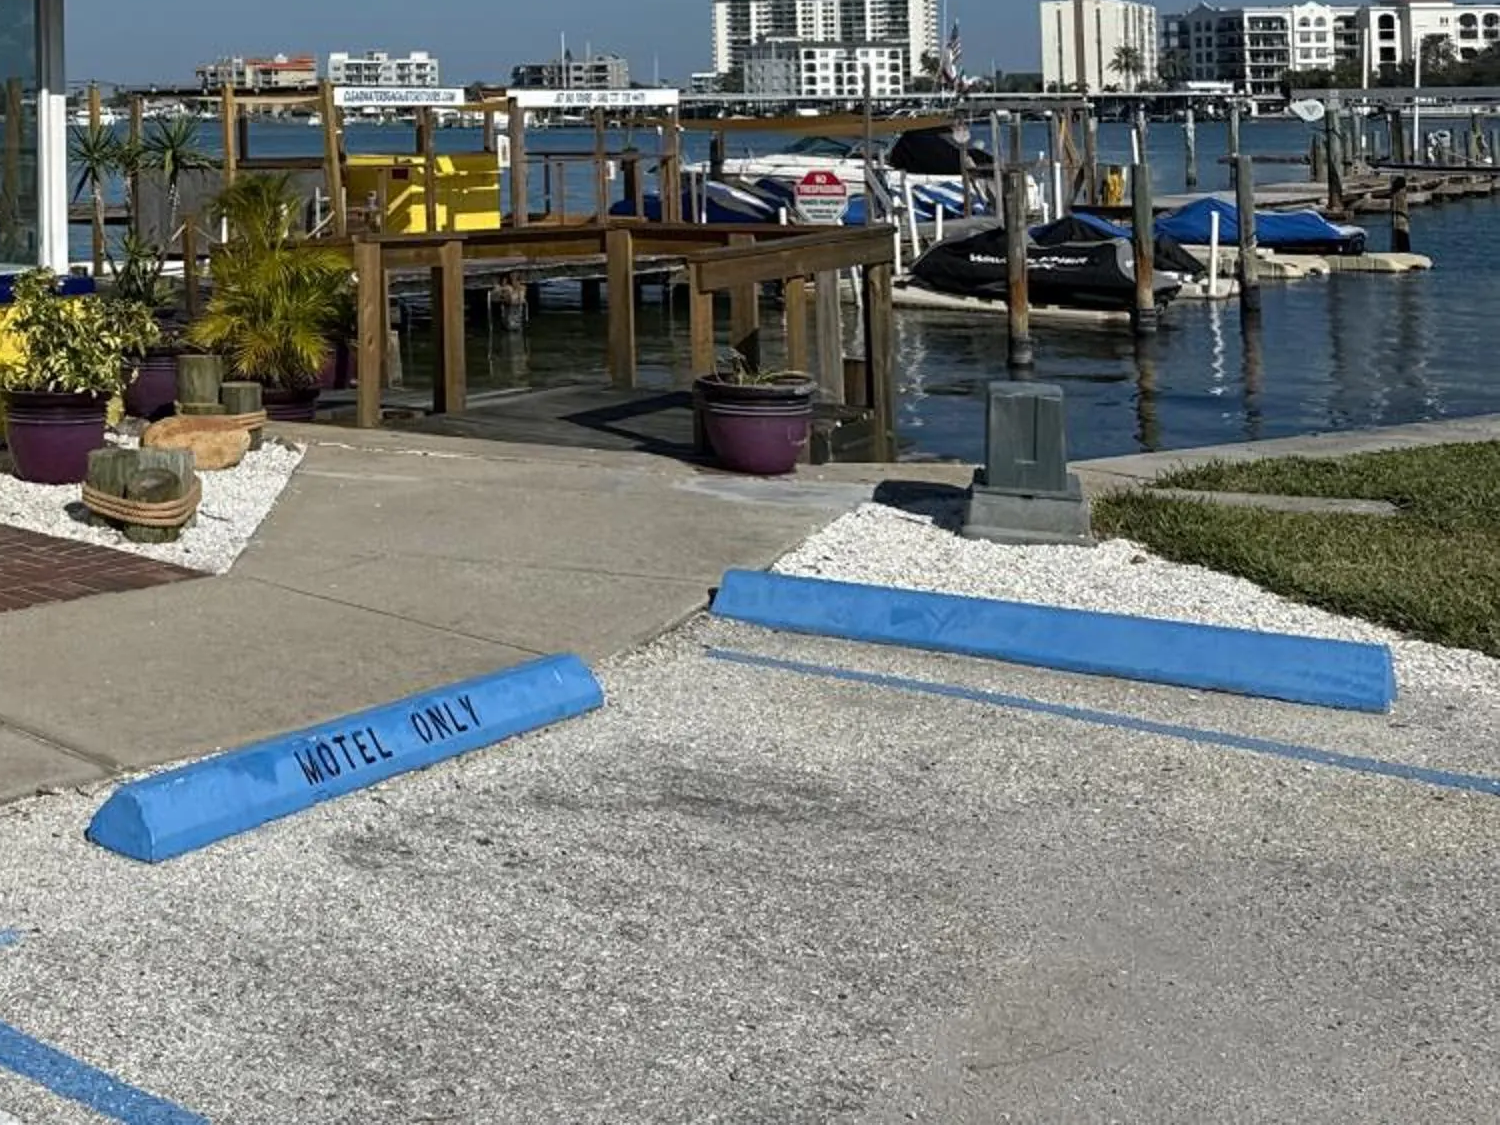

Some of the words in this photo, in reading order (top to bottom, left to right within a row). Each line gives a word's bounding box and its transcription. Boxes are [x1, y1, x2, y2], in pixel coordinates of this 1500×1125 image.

[814, 174, 827, 184] NO
[293, 726, 394, 787] MOTEL
[408, 693, 483, 745] ONLY
